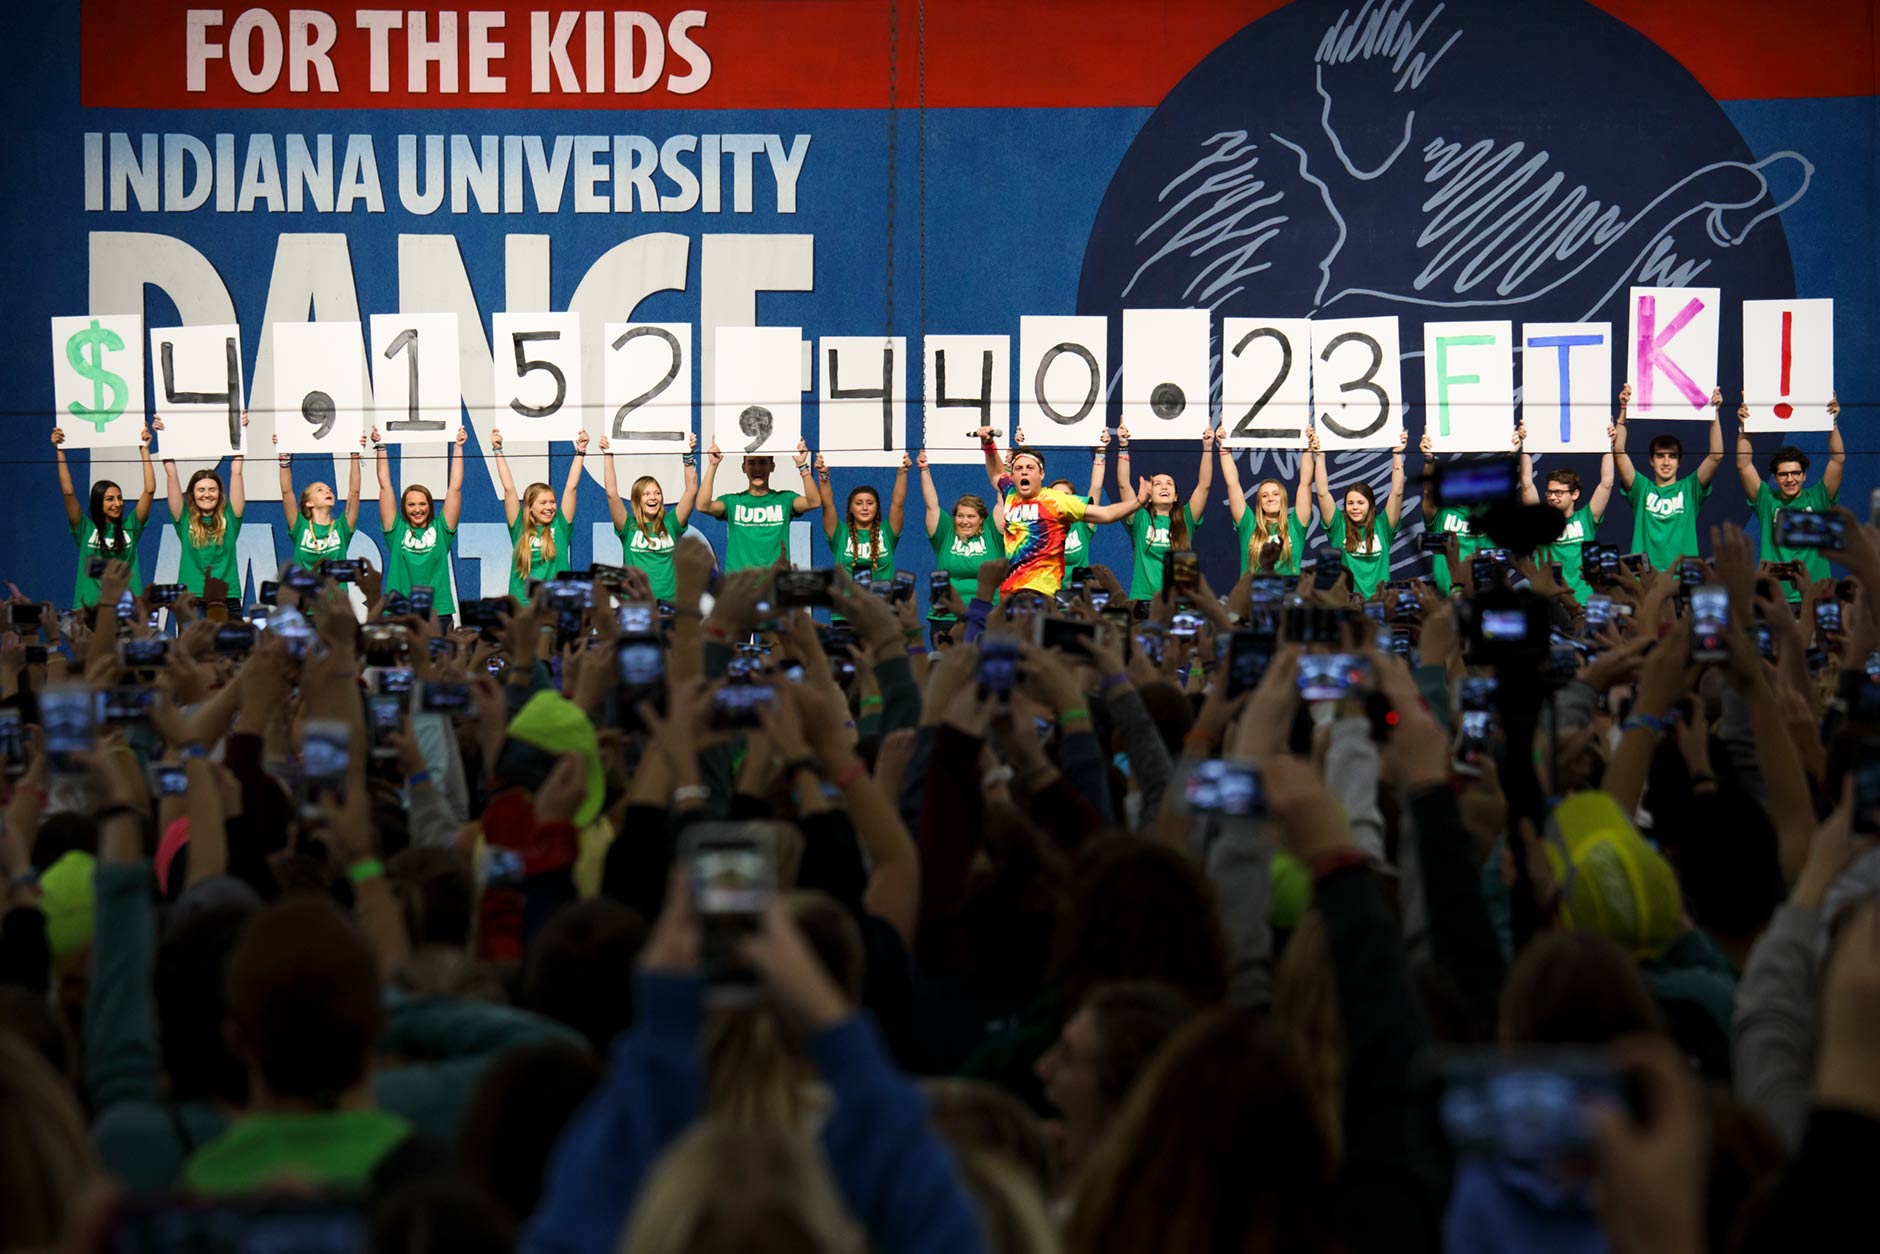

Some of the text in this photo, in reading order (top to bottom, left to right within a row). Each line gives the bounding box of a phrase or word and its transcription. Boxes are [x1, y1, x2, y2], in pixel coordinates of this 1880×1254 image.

[185, 8, 713, 95] FOR THE KIDS
[83, 131, 812, 215] INDIANA UNIVERSITY
[734, 504, 784, 523] IUDM
[1646, 491, 1684, 516] IUDM
